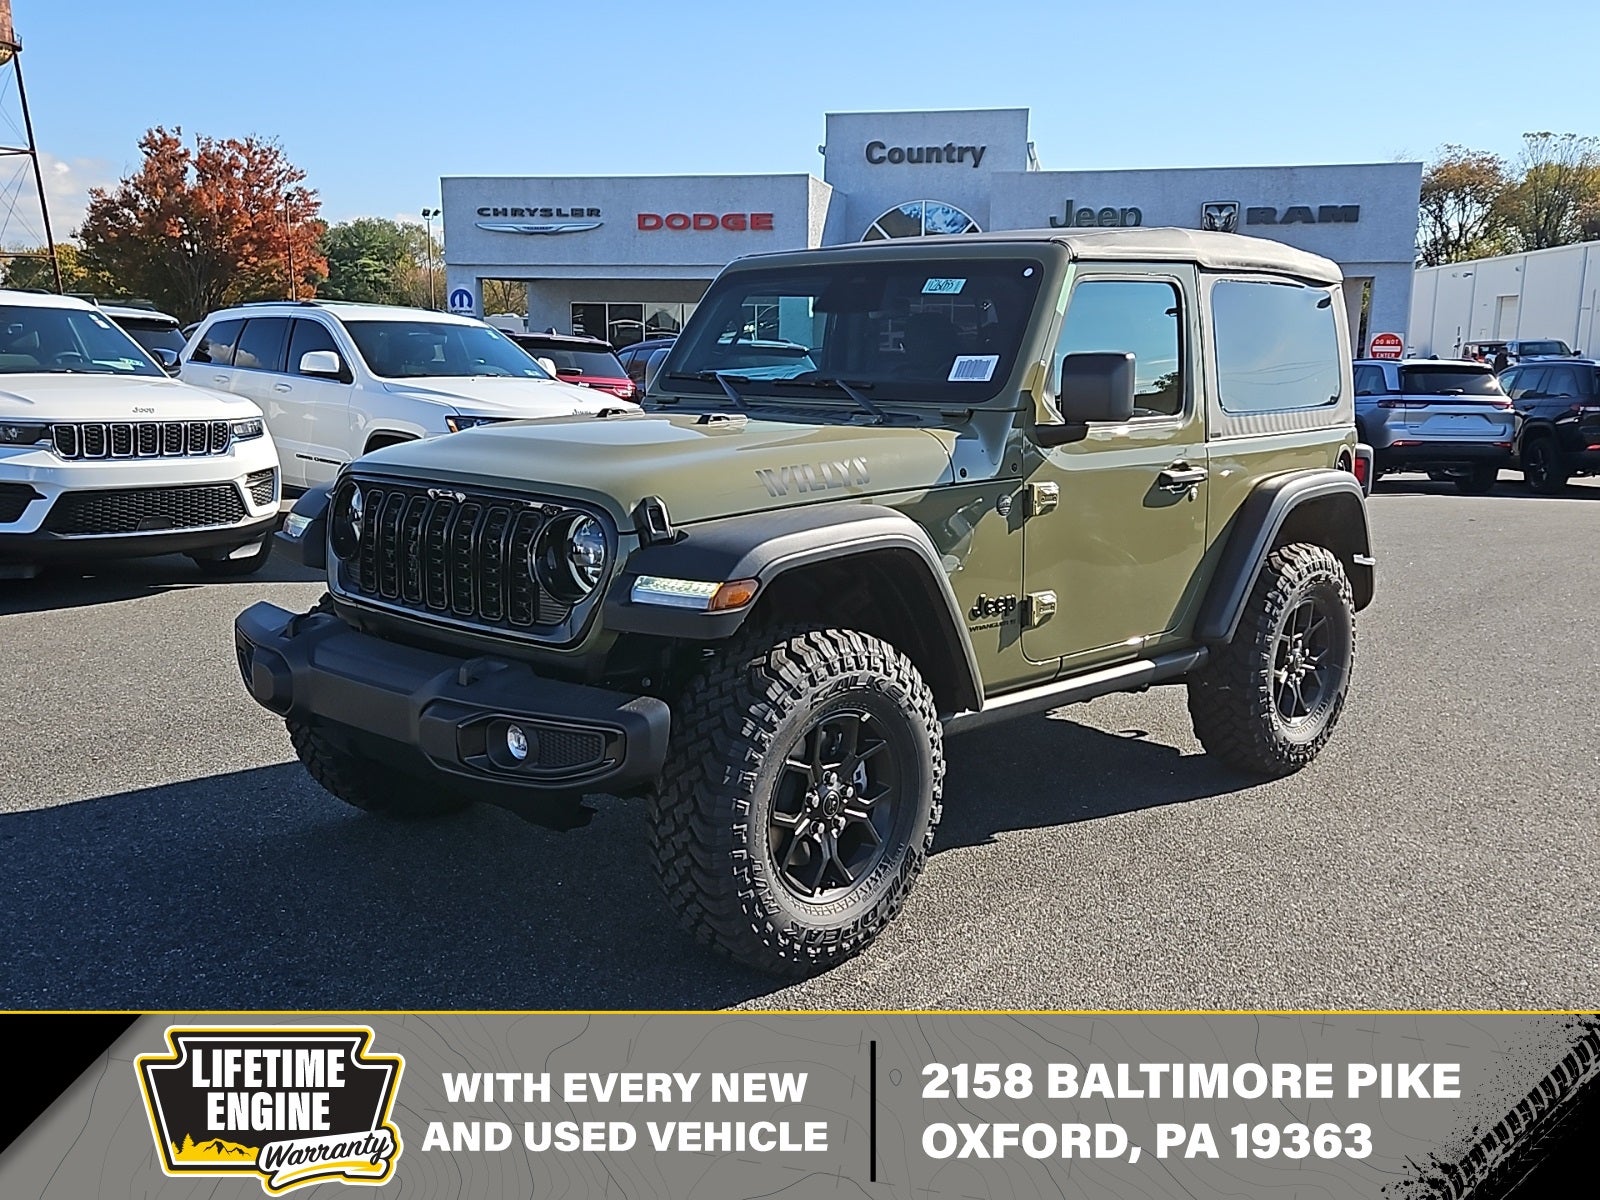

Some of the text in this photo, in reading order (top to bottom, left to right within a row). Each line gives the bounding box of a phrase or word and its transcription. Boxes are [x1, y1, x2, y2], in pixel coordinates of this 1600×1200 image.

[865, 140, 988, 169] Country
[476, 207, 602, 218] CHRYSLER
[637, 213, 774, 231] DODGE
[1049, 199, 1143, 228] Jeep
[1246, 205, 1361, 225] RAM
[755, 456, 870, 498] WILLYS
